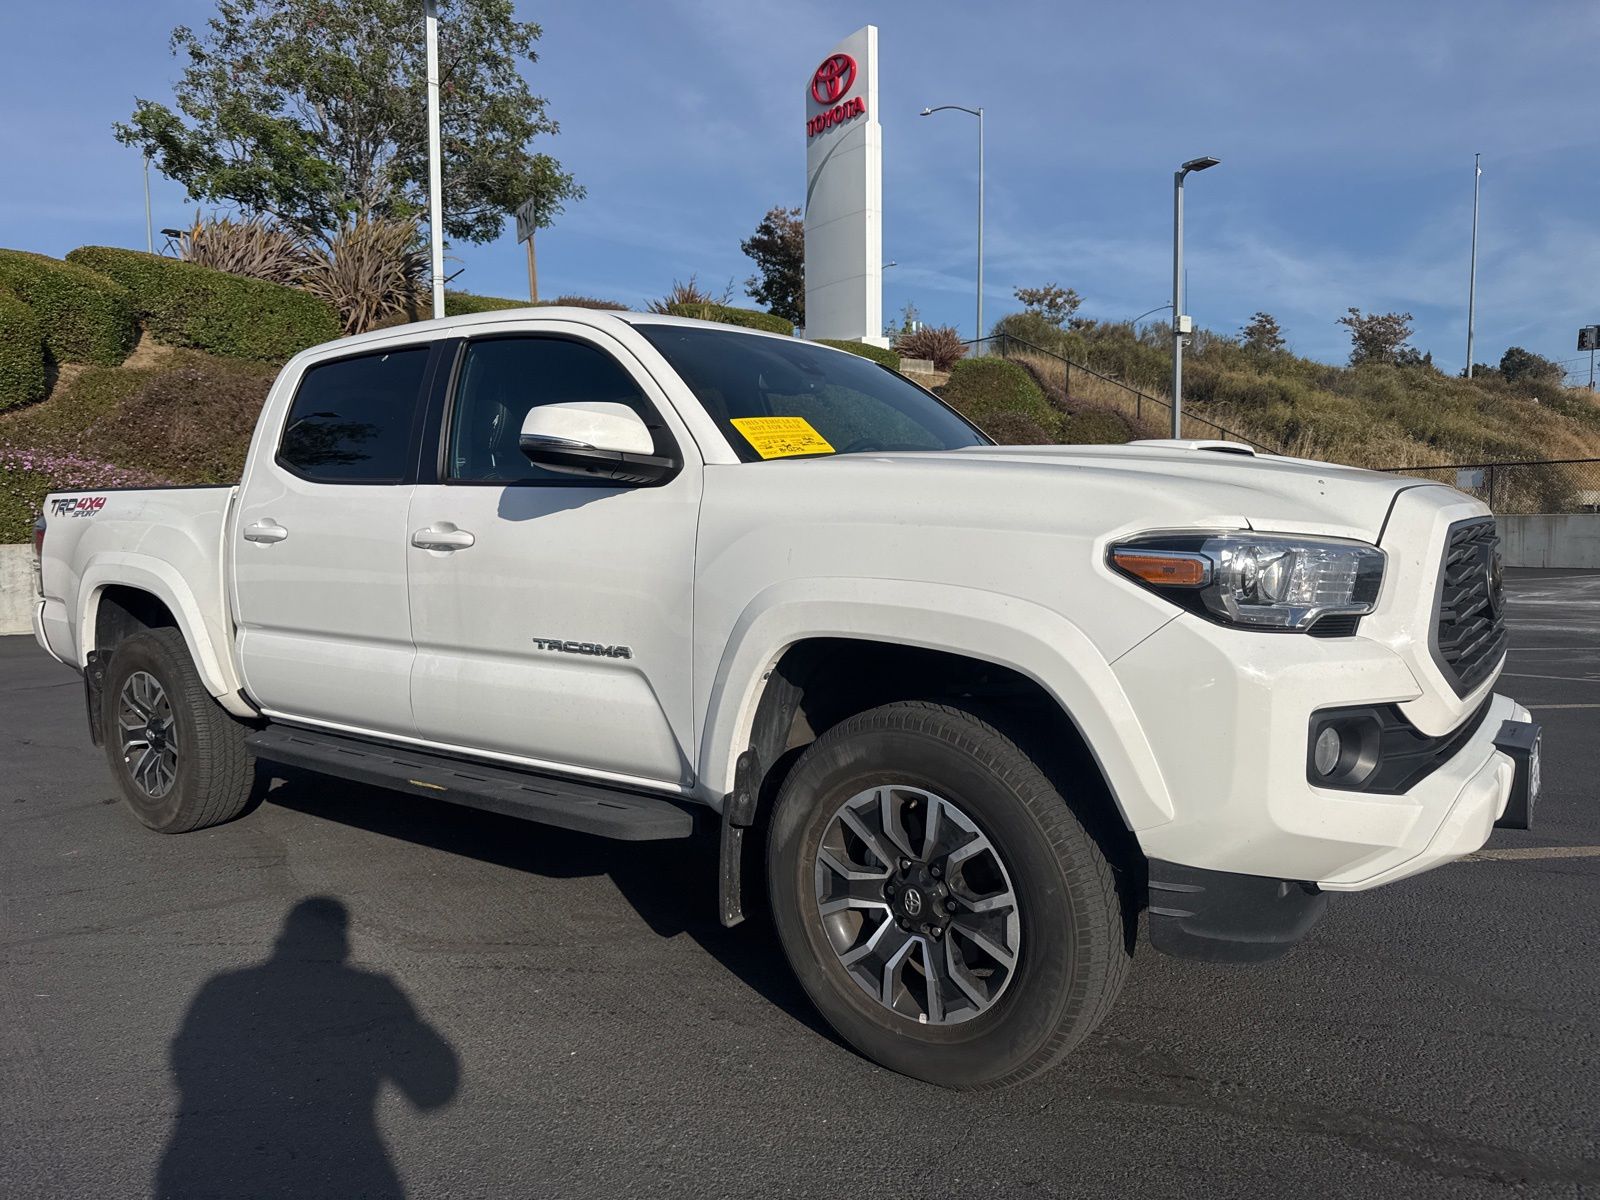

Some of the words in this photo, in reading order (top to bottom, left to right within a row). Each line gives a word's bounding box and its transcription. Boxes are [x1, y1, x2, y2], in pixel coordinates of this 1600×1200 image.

[806, 97, 865, 137] TOYOTA
[51, 499, 78, 517] TRD
[532, 638, 632, 659] TACOMA
